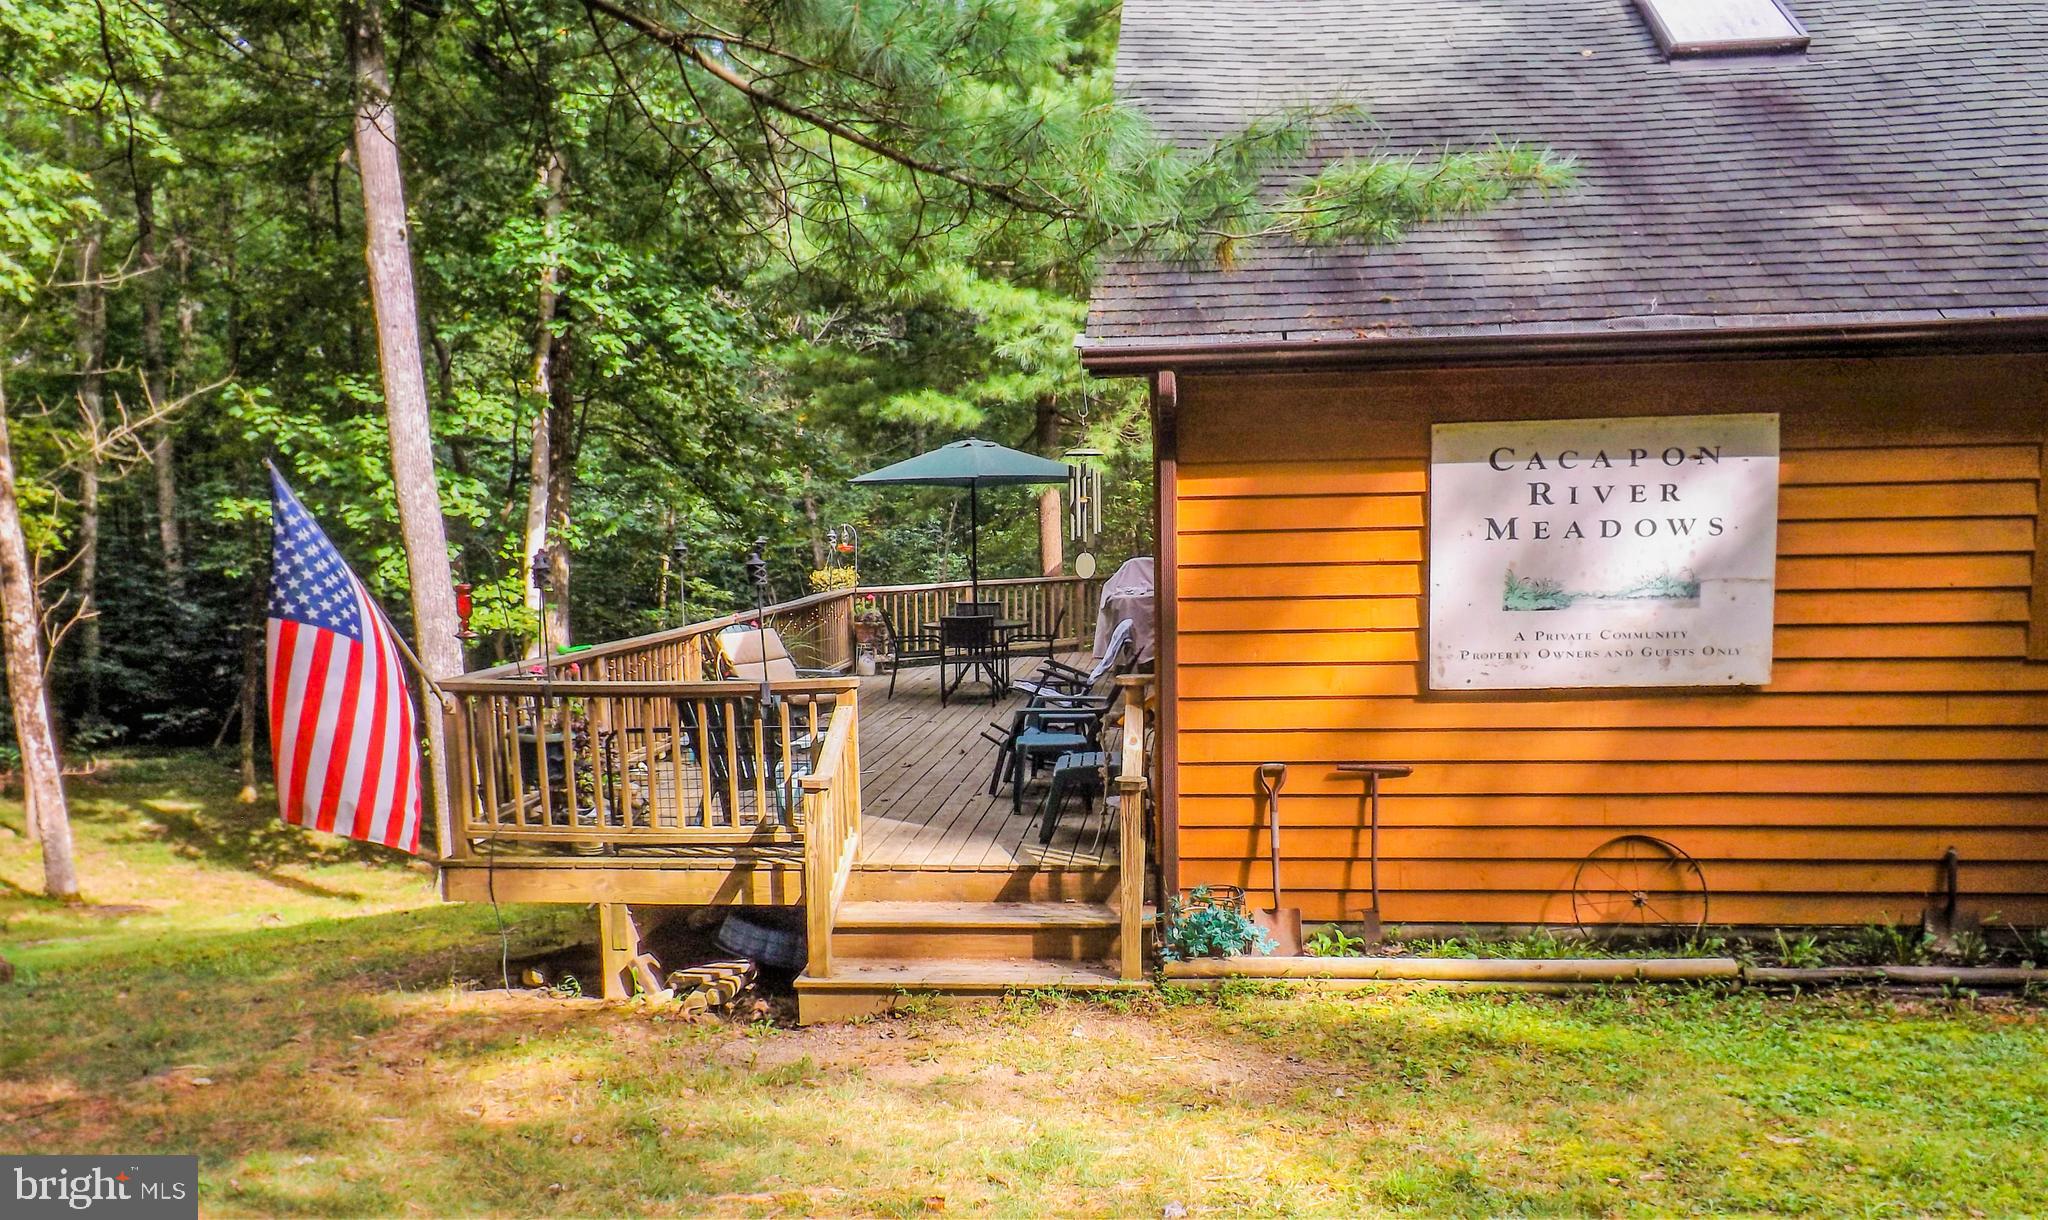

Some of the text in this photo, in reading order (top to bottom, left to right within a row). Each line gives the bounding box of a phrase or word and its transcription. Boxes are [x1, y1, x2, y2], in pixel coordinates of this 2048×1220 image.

[1488, 445, 1722, 472] CACAPON
[1527, 481, 1682, 506] RIVER
[1484, 516, 1725, 541] MEADOWS
[1514, 629, 1688, 641] A PRIVATE COMMUNITY
[1460, 645, 1741, 660] PROPERTY OWNERS AND GUESTS ONLY
